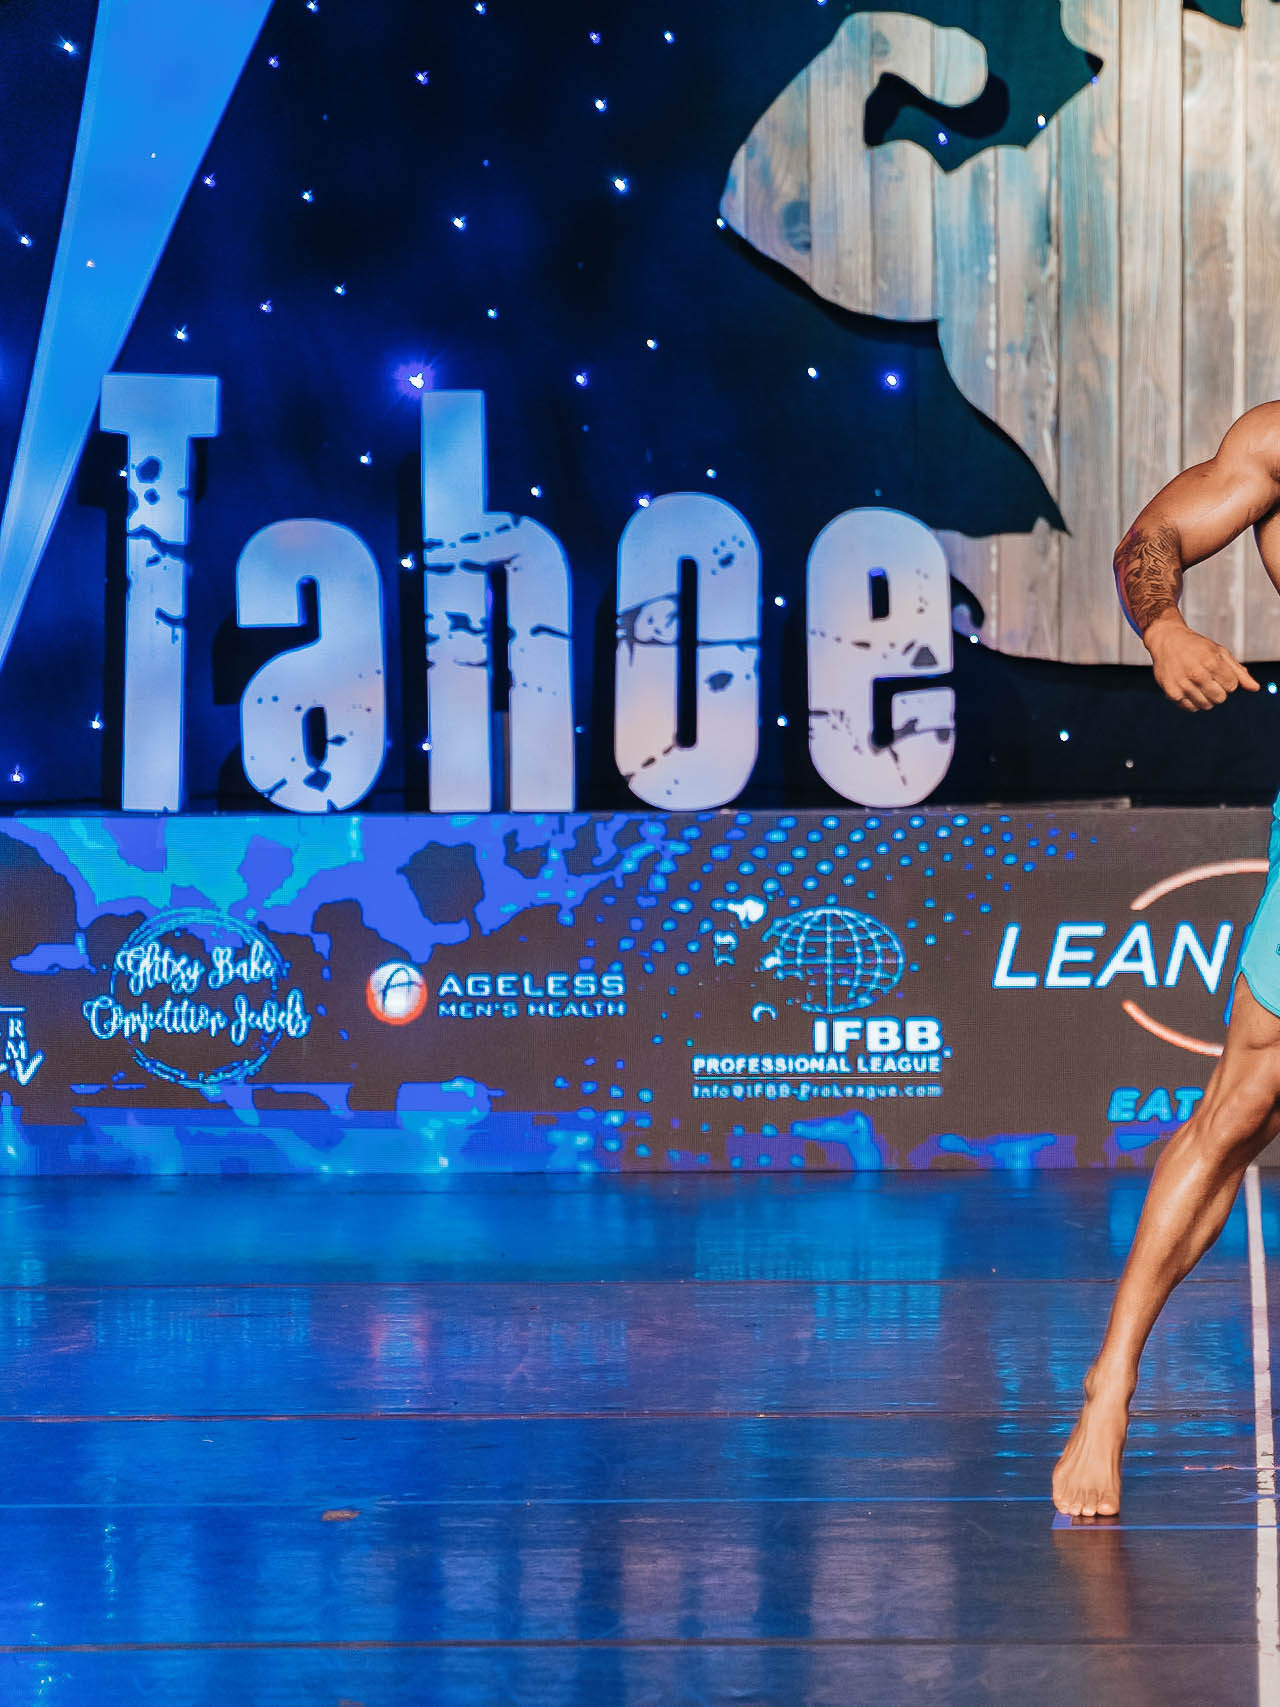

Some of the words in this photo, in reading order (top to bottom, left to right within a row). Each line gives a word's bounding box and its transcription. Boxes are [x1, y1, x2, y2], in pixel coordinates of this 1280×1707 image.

[98, 373, 956, 813] Tahoe
[993, 921, 1233, 992] LEAN
[437, 972, 627, 998] AGELESS
[437, 1000, 519, 1019] MEN'S
[527, 1000, 627, 1019] HEALTH
[813, 1016, 944, 1054] IFBB
[692, 1054, 853, 1074] PROFESSIONAL
[856, 1054, 944, 1073] LEAGUE
[1106, 1086, 1205, 1122] EAT
